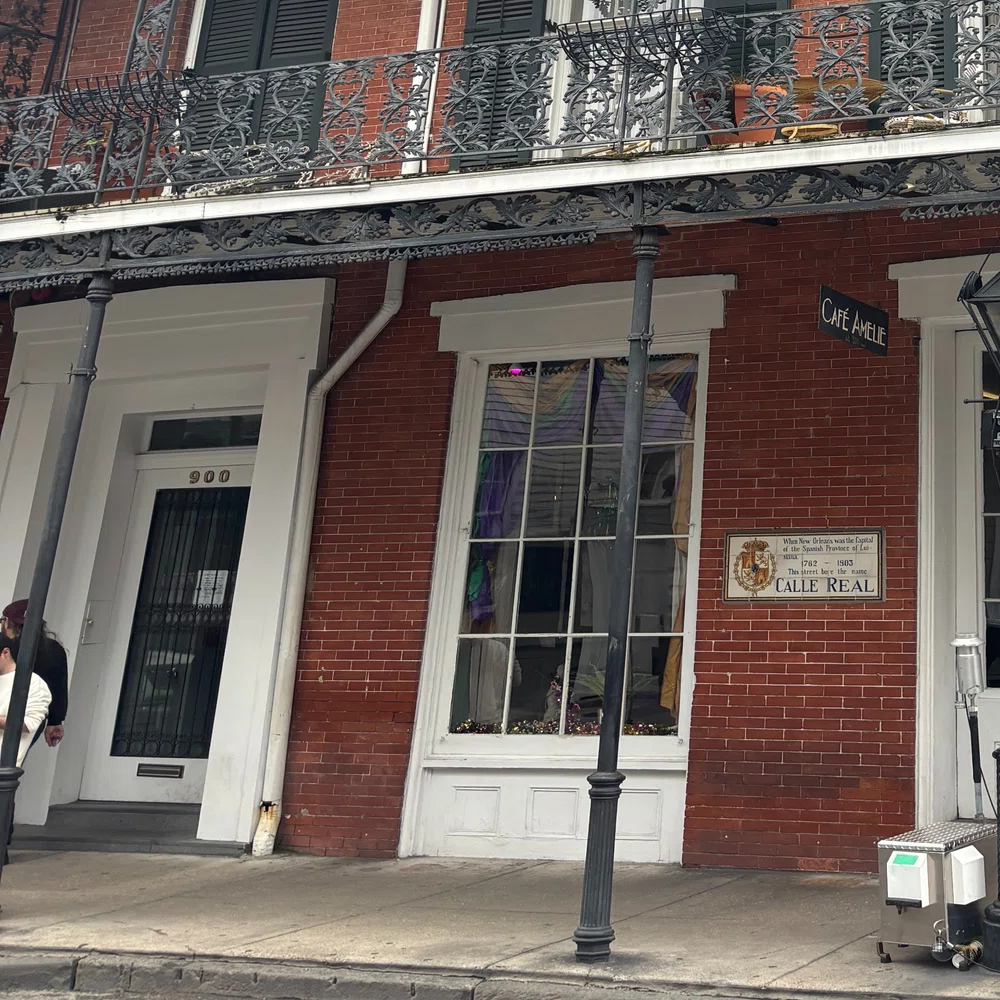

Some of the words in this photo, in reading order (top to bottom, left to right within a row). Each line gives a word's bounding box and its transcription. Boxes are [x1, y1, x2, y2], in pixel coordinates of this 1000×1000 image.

[822, 297, 850, 332] CAFÉ
[851, 310, 887, 347] AMELIE
[189, 469, 230, 484] 900
[783, 537, 798, 545] When
[812, 537, 833, 545] Orleans
[802, 544, 823, 553] Spanish
[825, 544, 849, 552] Province
[775, 577, 818, 593] CALLE
[826, 577, 875, 593] REAL
